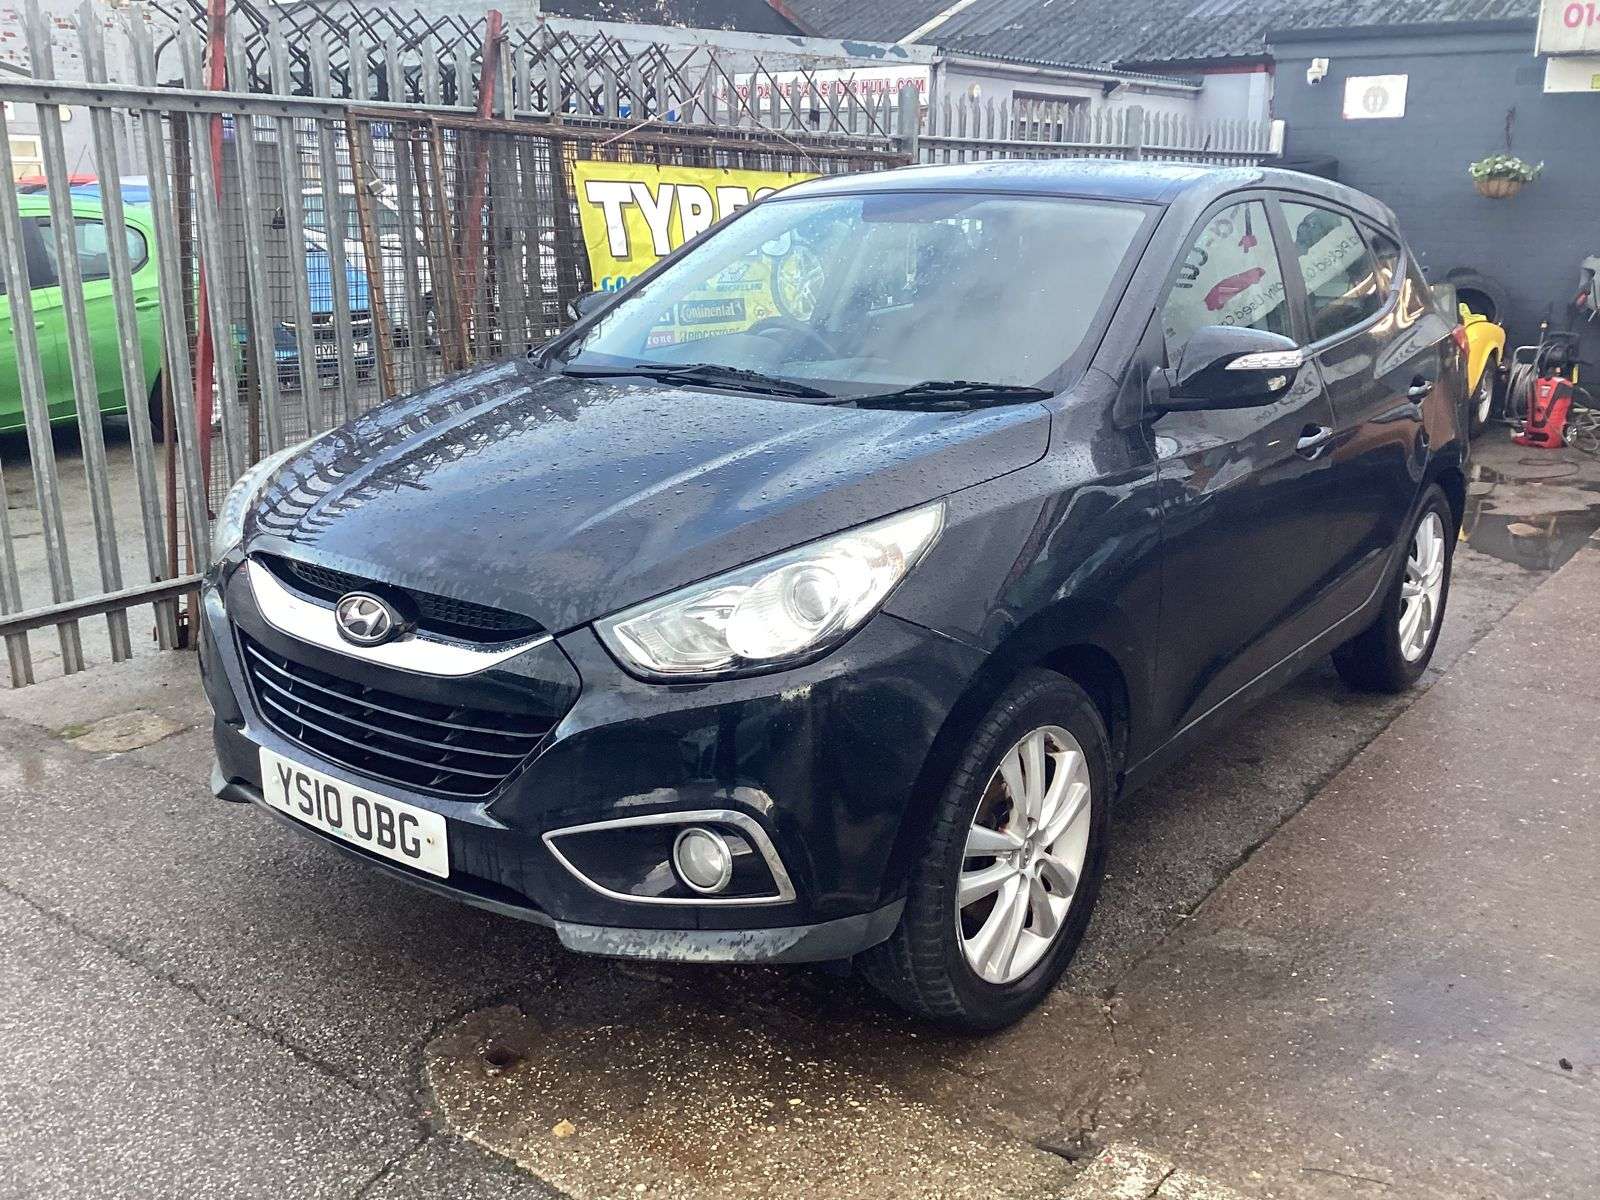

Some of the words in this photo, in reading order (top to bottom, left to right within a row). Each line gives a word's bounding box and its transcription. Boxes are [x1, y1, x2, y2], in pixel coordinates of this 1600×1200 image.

[1563, 3, 1600, 28] 01
[585, 181, 780, 257] TYR
[277, 762, 343, 828] YS10
[352, 795, 421, 859] OBG
